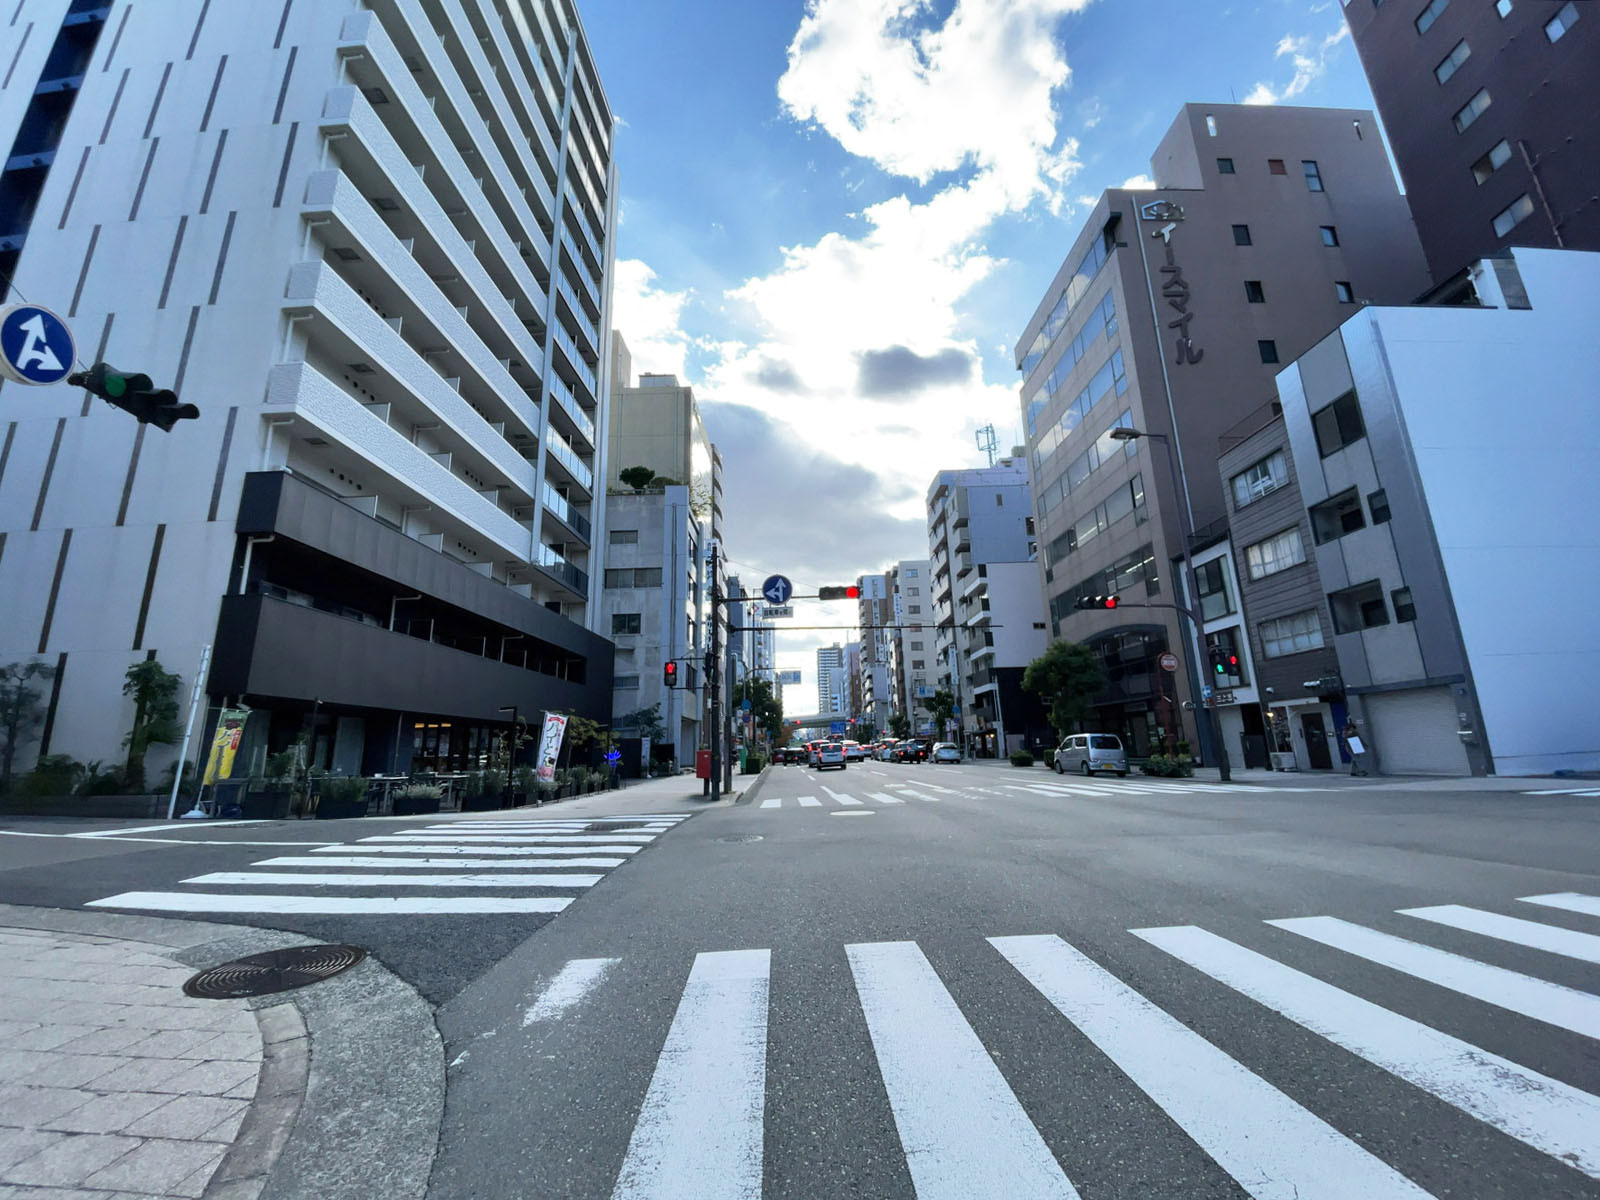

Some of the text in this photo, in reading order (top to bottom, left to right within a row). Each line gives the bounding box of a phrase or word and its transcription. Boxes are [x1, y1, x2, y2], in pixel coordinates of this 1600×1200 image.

[1151, 222, 1204, 366] イースマイル
